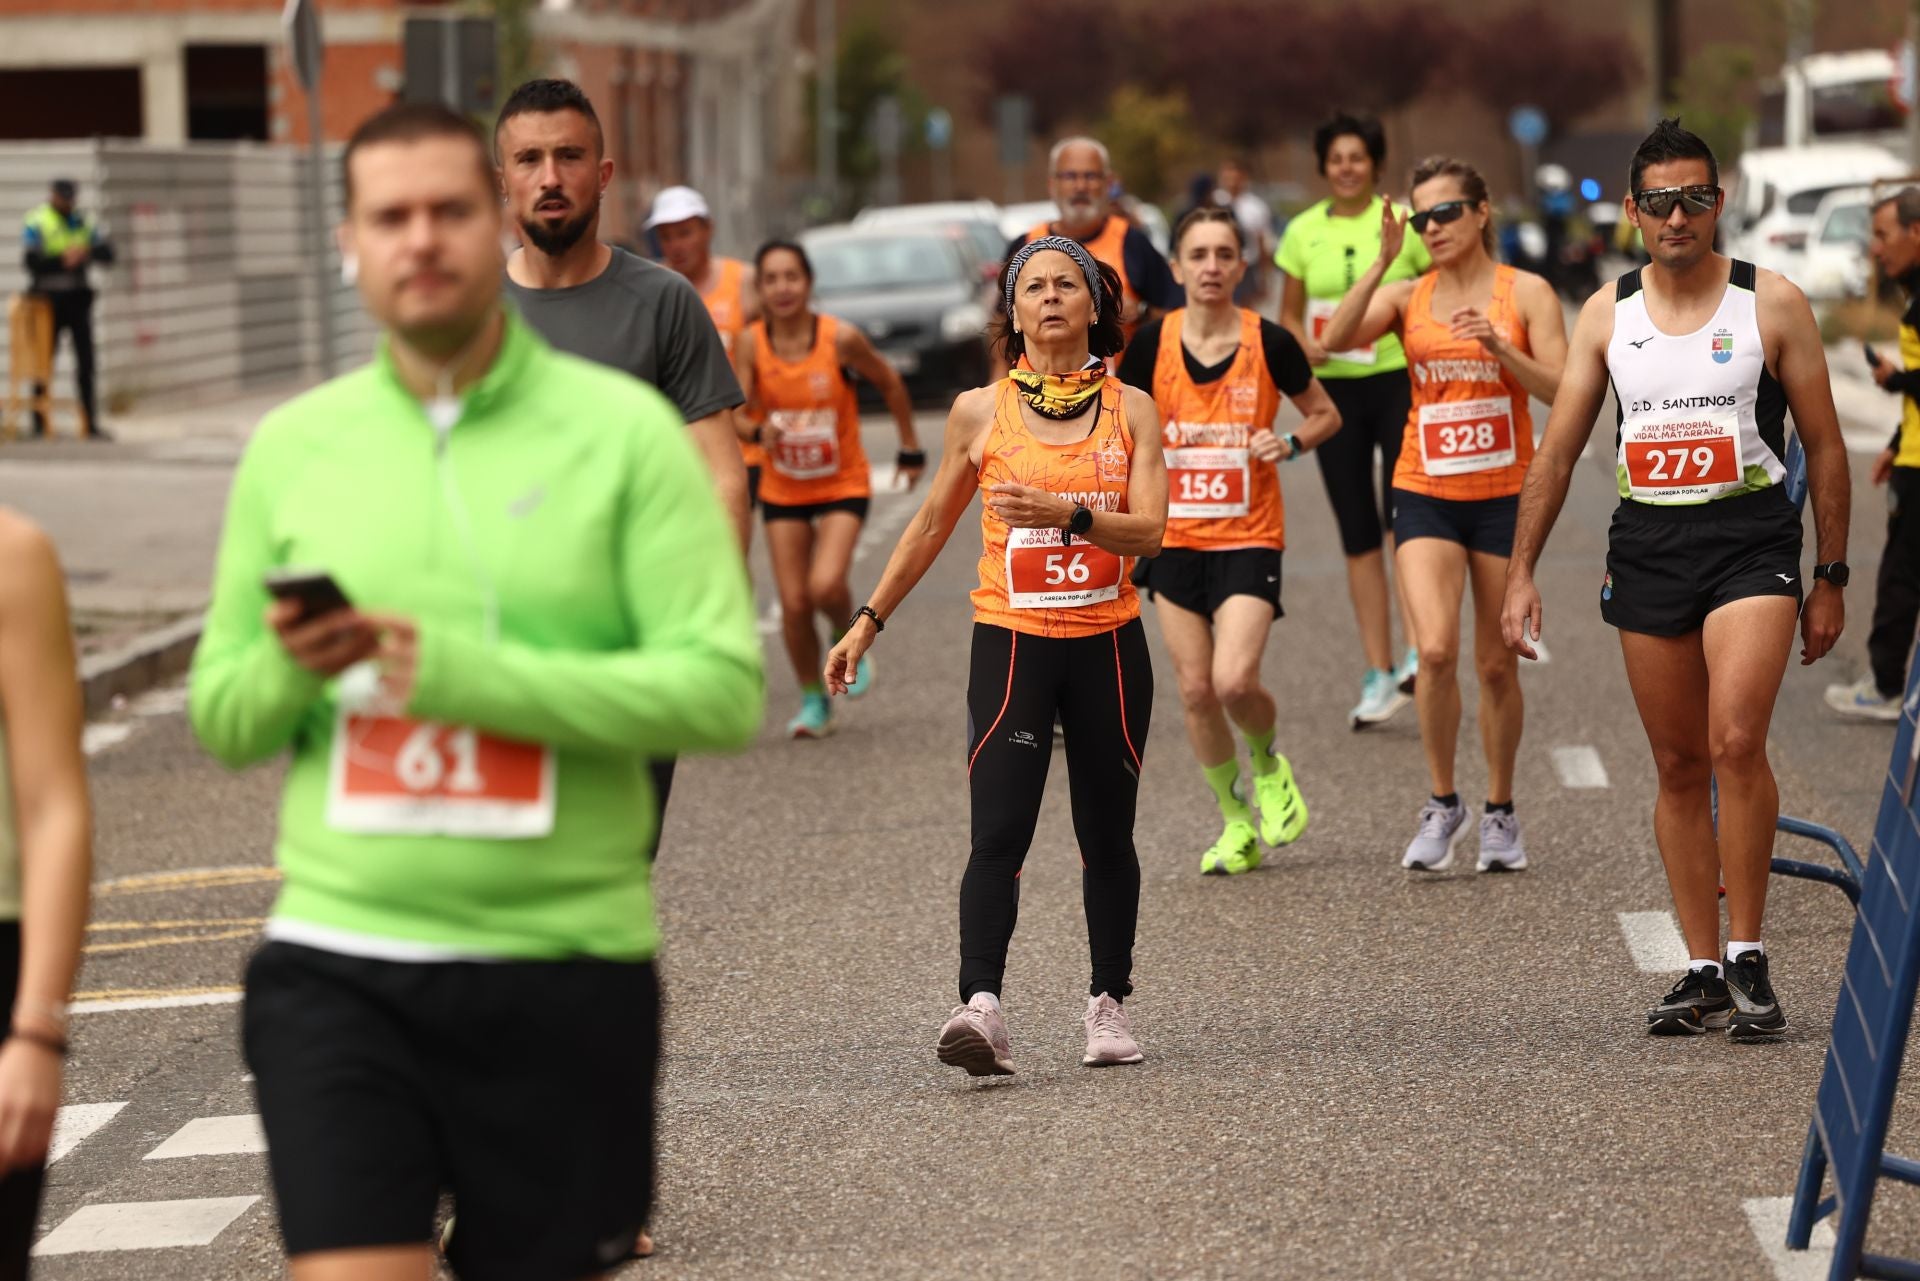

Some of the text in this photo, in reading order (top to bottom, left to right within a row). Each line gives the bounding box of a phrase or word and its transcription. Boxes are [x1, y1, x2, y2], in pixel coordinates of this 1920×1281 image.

[1631, 395, 1736, 412] C.D. SANTINOS
[1439, 422, 1495, 454] 328
[1633, 426, 1725, 440] VIDAL-MATARRANZ
[1641, 420, 1714, 432] XXIX MEMORIAL
[1645, 446, 1714, 480] 279
[1179, 472, 1229, 500] 156
[1029, 528, 1050, 537] XXIX
[1045, 552, 1090, 585] 56
[395, 721, 487, 792] 61
